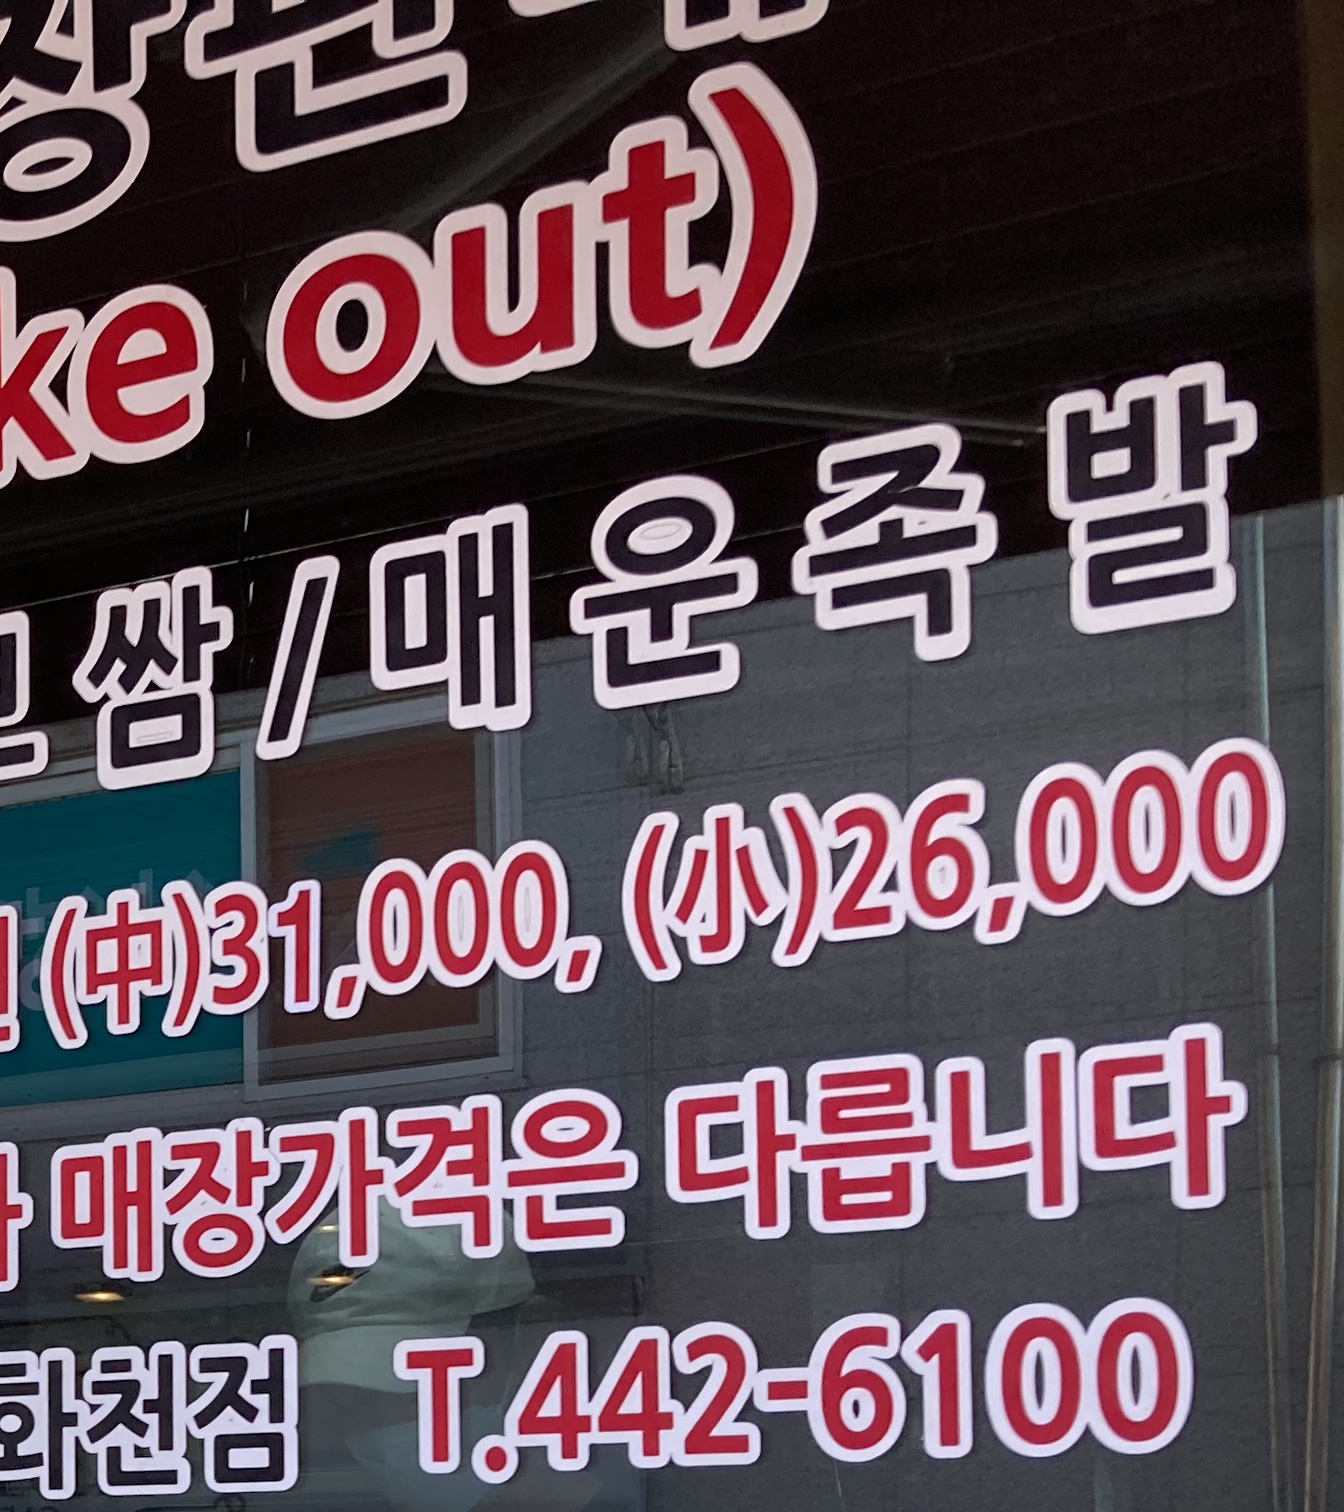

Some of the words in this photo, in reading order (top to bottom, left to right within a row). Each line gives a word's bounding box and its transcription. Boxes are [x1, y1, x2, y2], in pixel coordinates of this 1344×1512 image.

[268, 60, 819, 420] out)
[622, 732, 1284, 978] (小)26,000
[50, 1087, 635, 1280] 매장가격은
[665, 1022, 1248, 1240] 다릅니다
[393, 1295, 1196, 1482] T.442-6100
